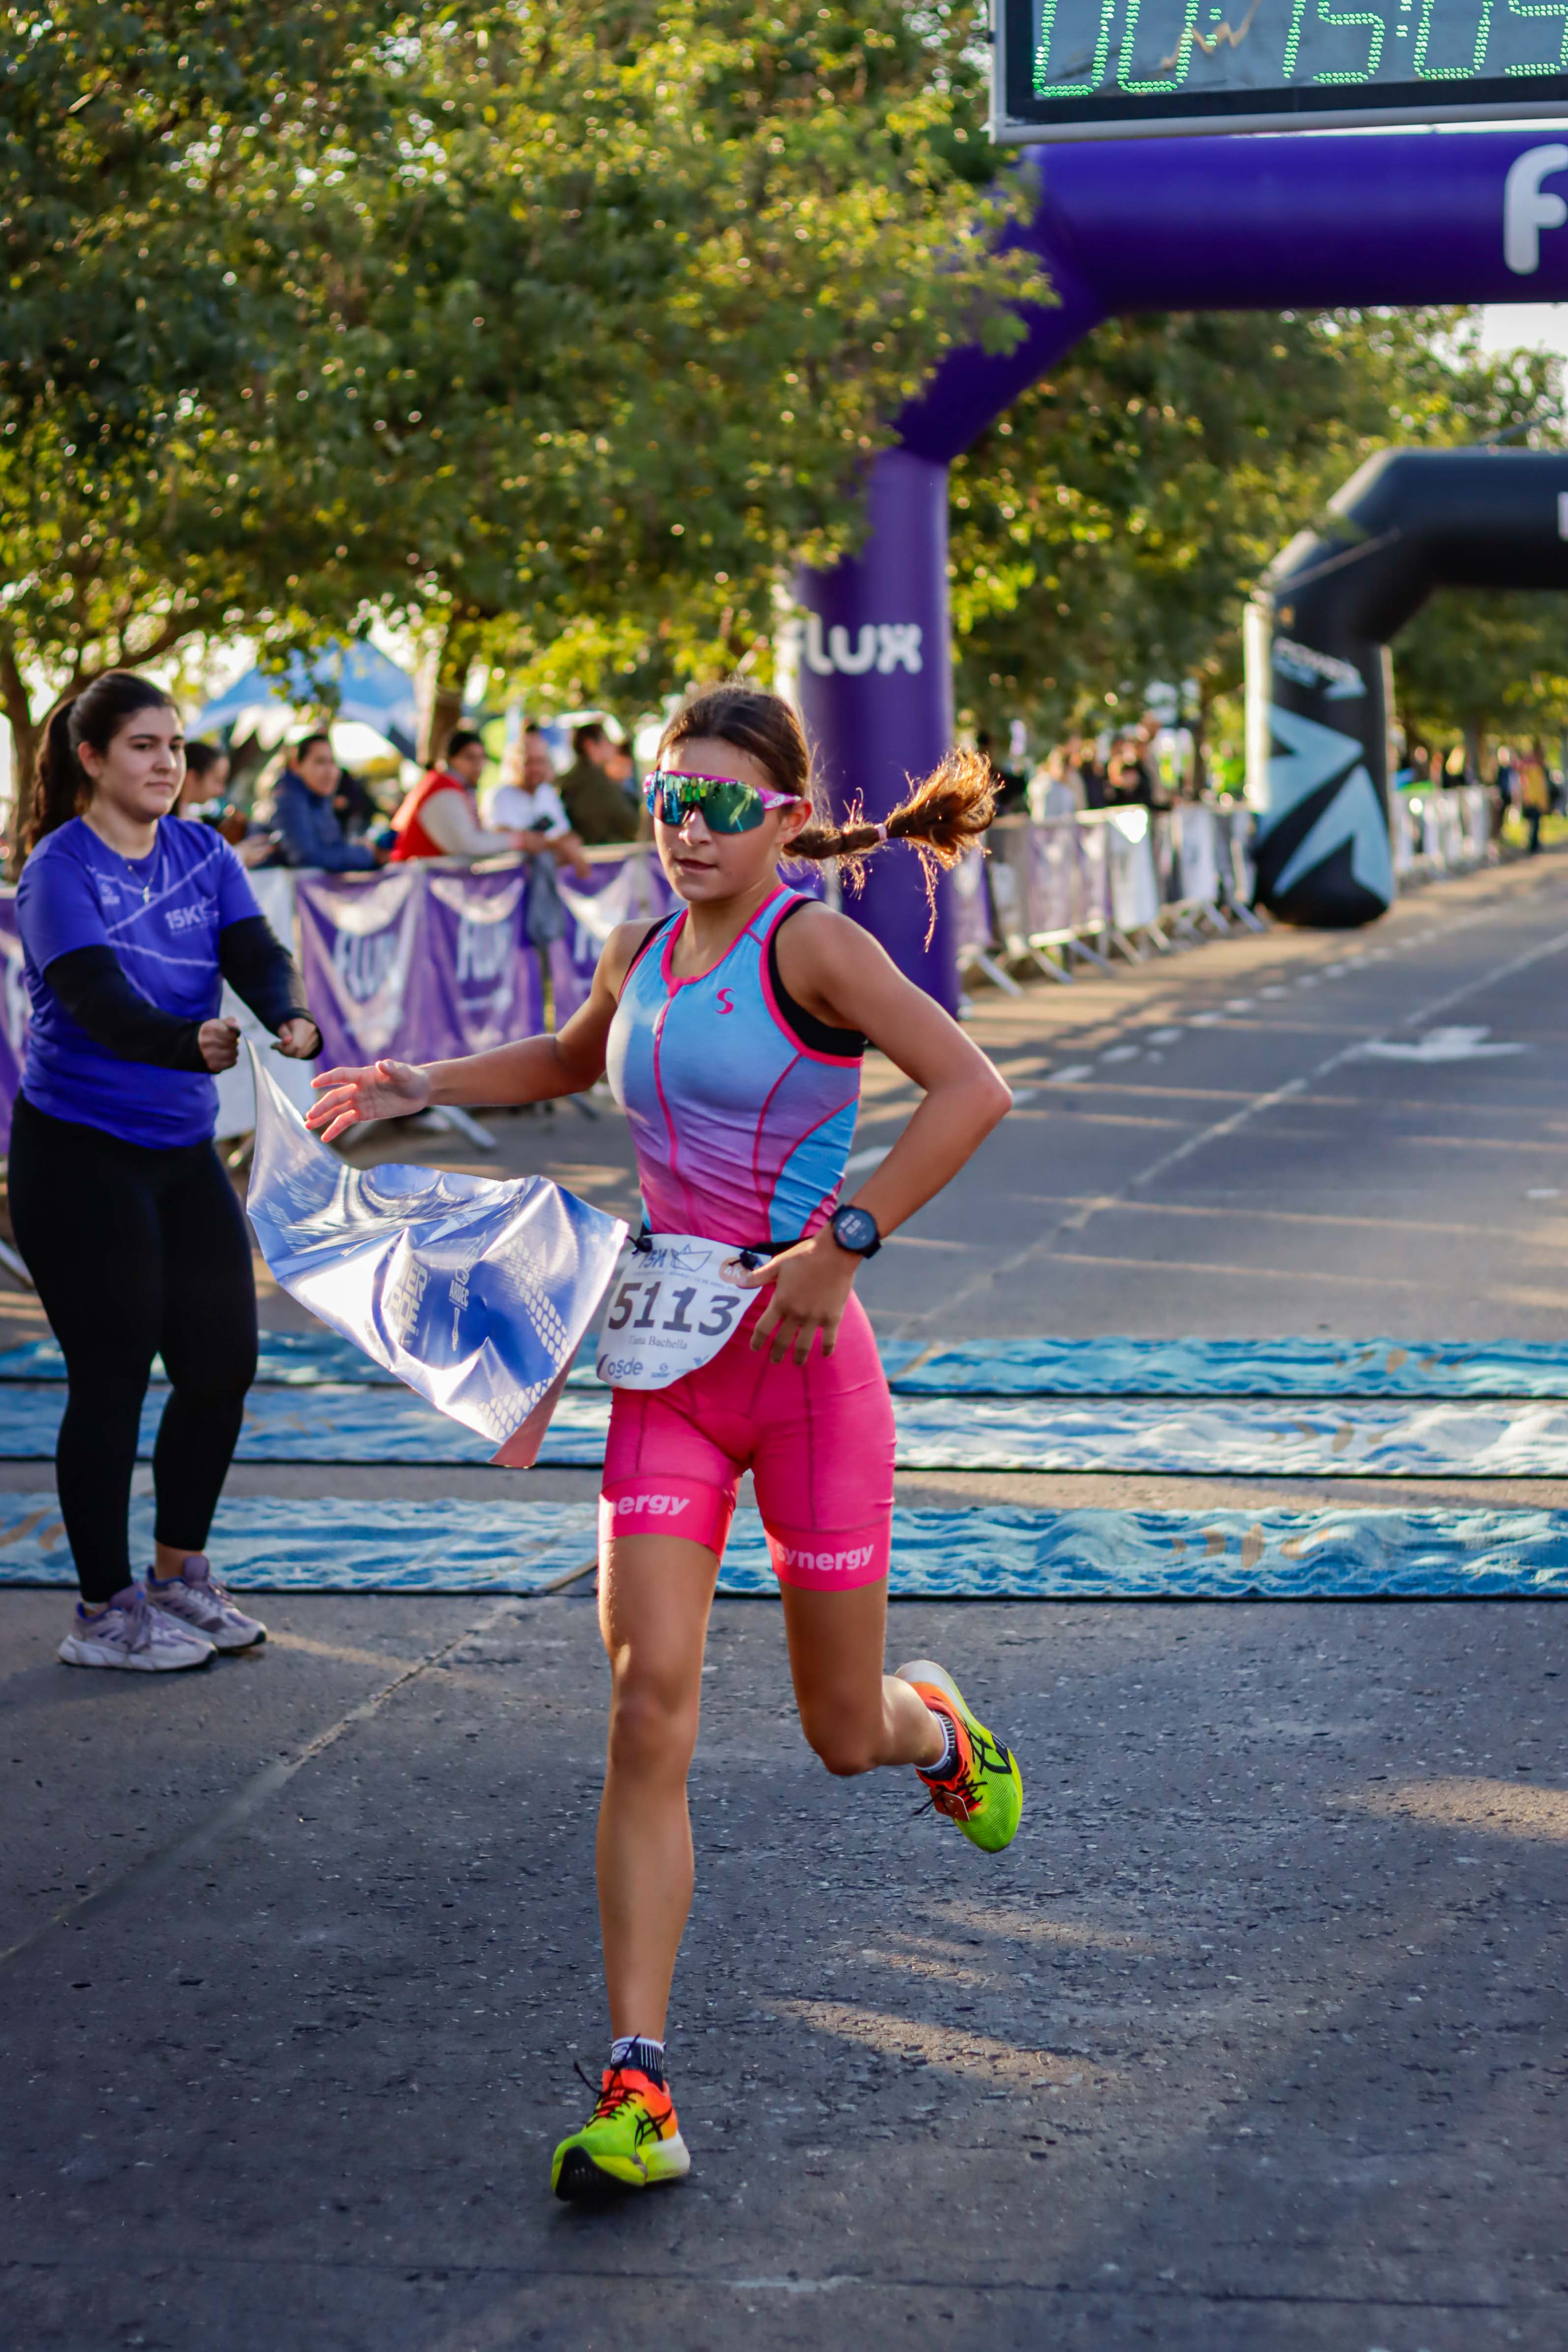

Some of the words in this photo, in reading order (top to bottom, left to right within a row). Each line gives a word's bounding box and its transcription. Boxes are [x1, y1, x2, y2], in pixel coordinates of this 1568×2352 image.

[608, 1281, 740, 1336] 5113
[607, 1356, 643, 1379] osde
[613, 1494, 690, 1516] ergy
